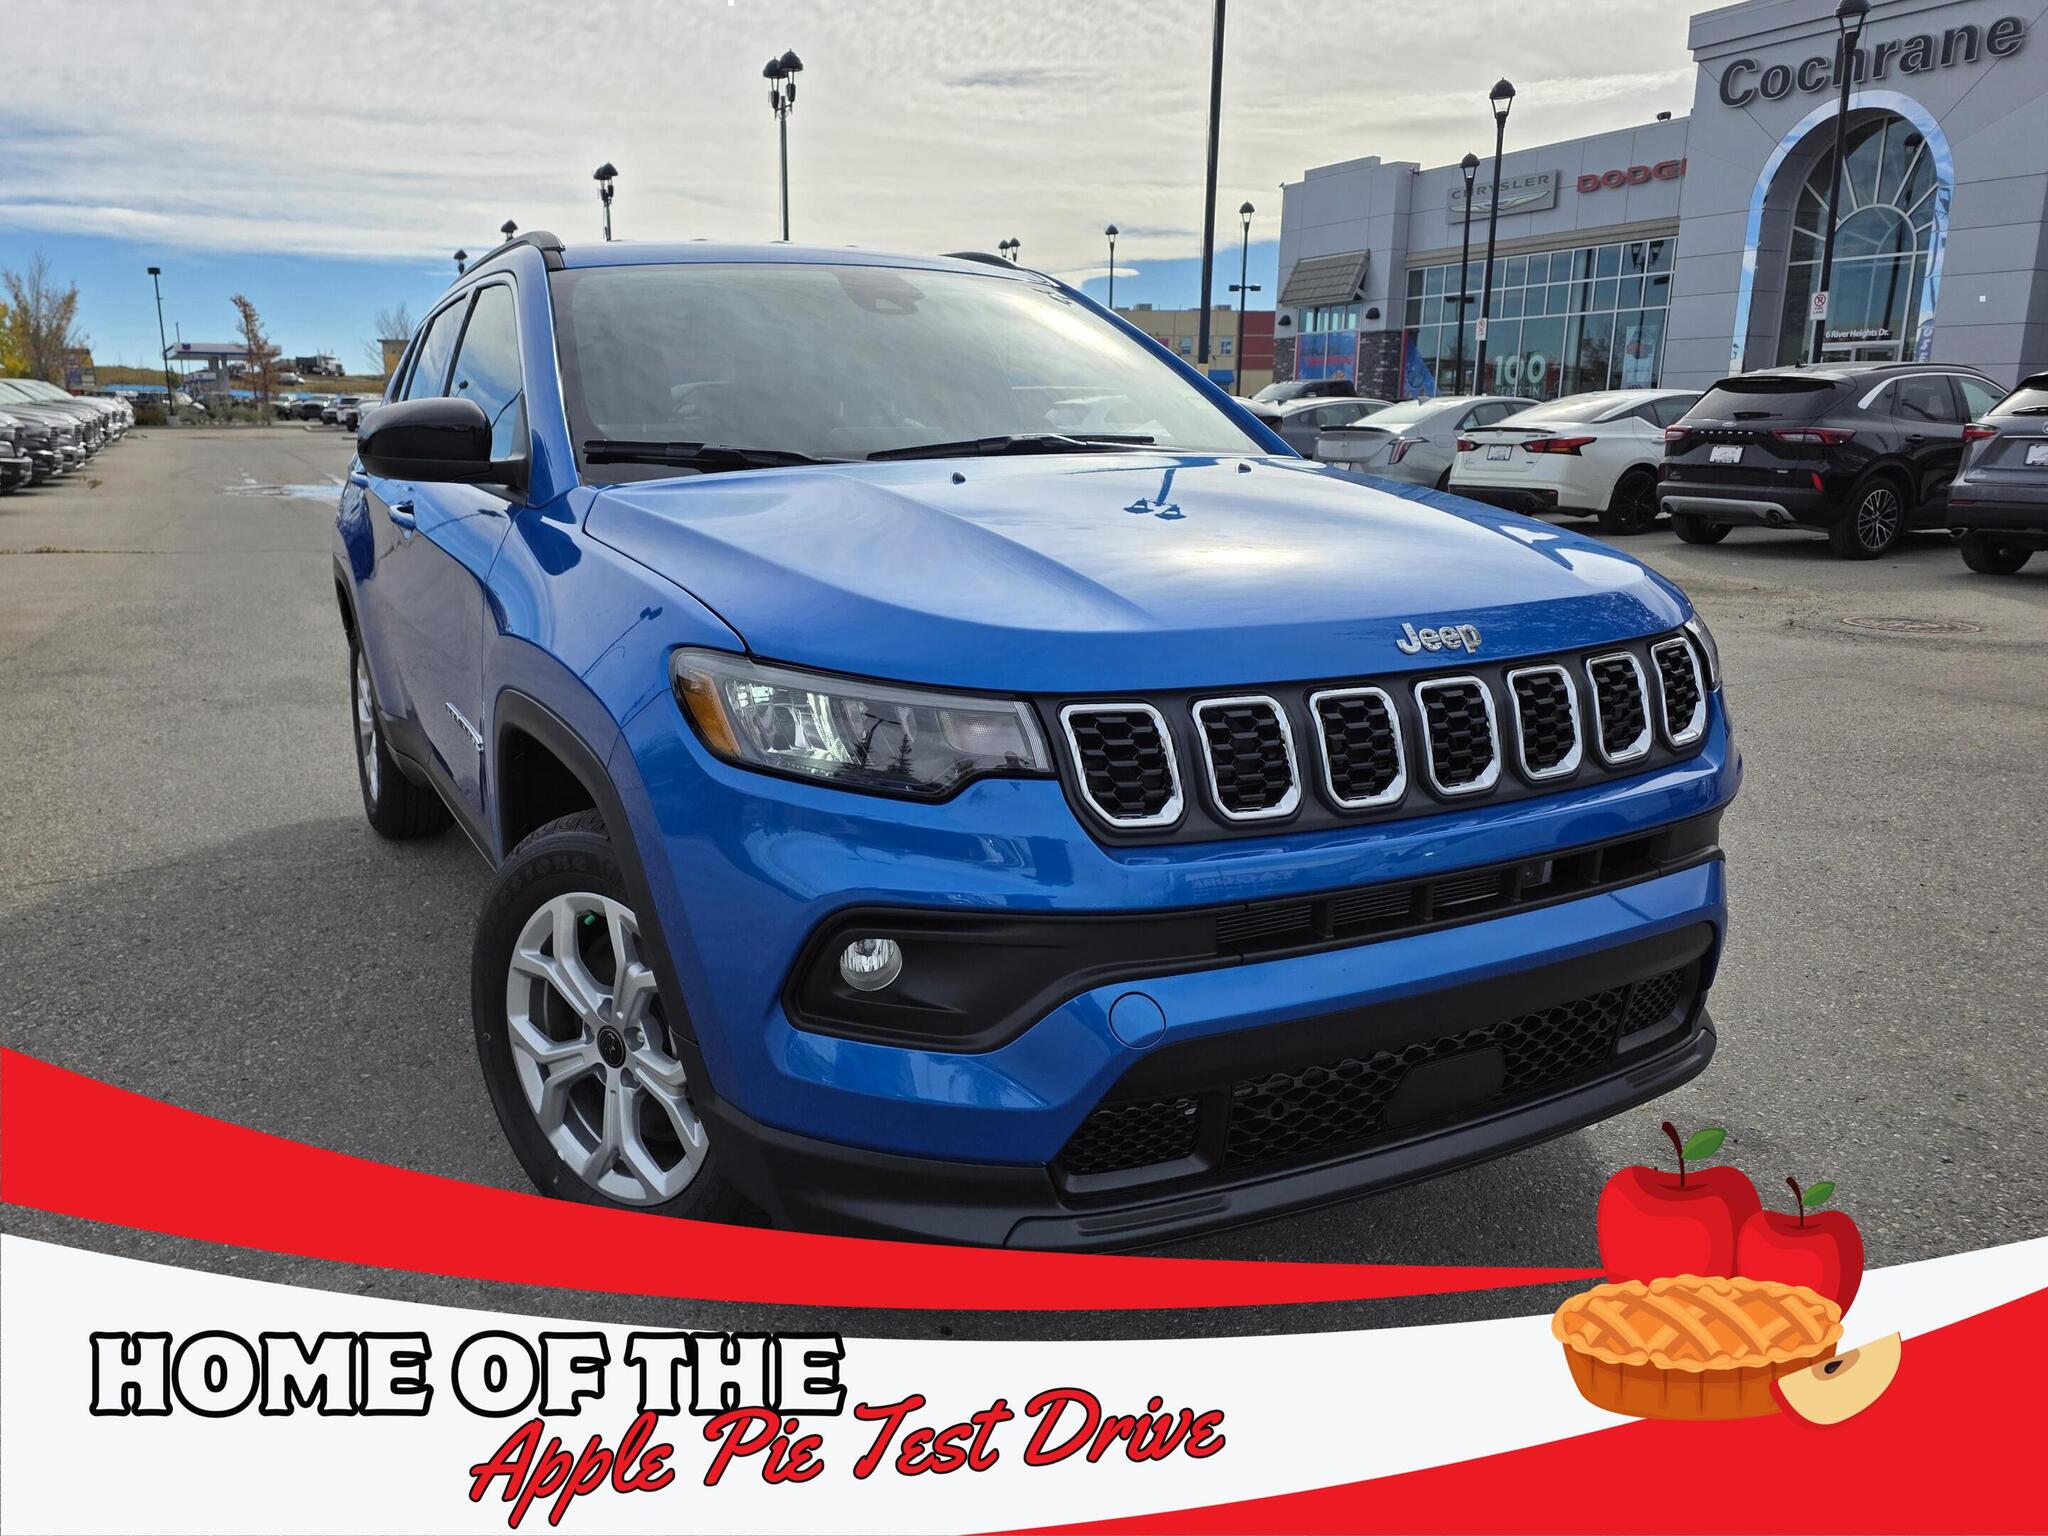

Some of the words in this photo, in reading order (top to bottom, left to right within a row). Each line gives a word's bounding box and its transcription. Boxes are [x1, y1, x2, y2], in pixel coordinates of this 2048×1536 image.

[1719, 15, 2028, 108] Cochrane
[1825, 331, 1831, 339] 6
[1831, 330, 1849, 339] River
[1850, 329, 1878, 339] Heights
[1878, 328, 1889, 337] Dr.
[1495, 355, 1546, 385] 100
[1396, 622, 1482, 655] Jeep
